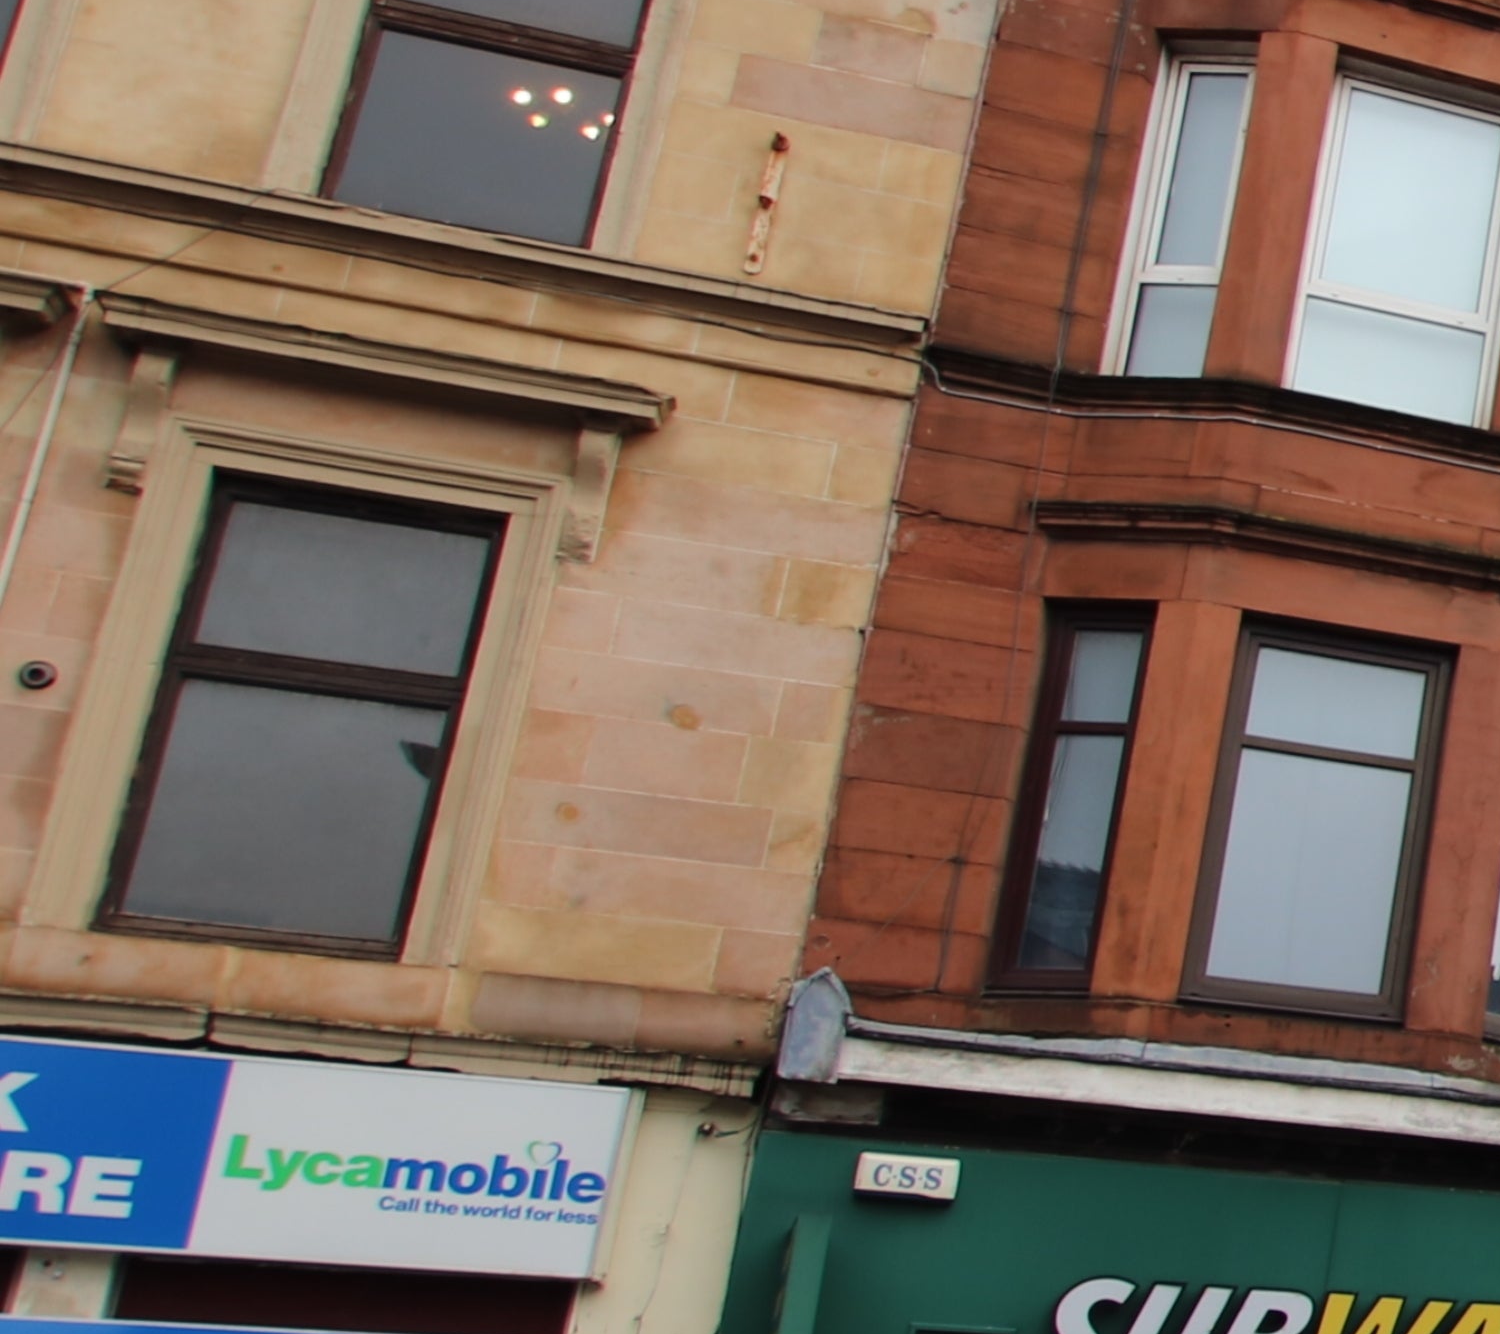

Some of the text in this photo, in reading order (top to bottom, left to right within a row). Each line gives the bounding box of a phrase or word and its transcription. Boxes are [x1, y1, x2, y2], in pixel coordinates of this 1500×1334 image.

[223, 1134, 606, 1203] Lycamobile
[378, 1196, 599, 1225] Call the world for less
